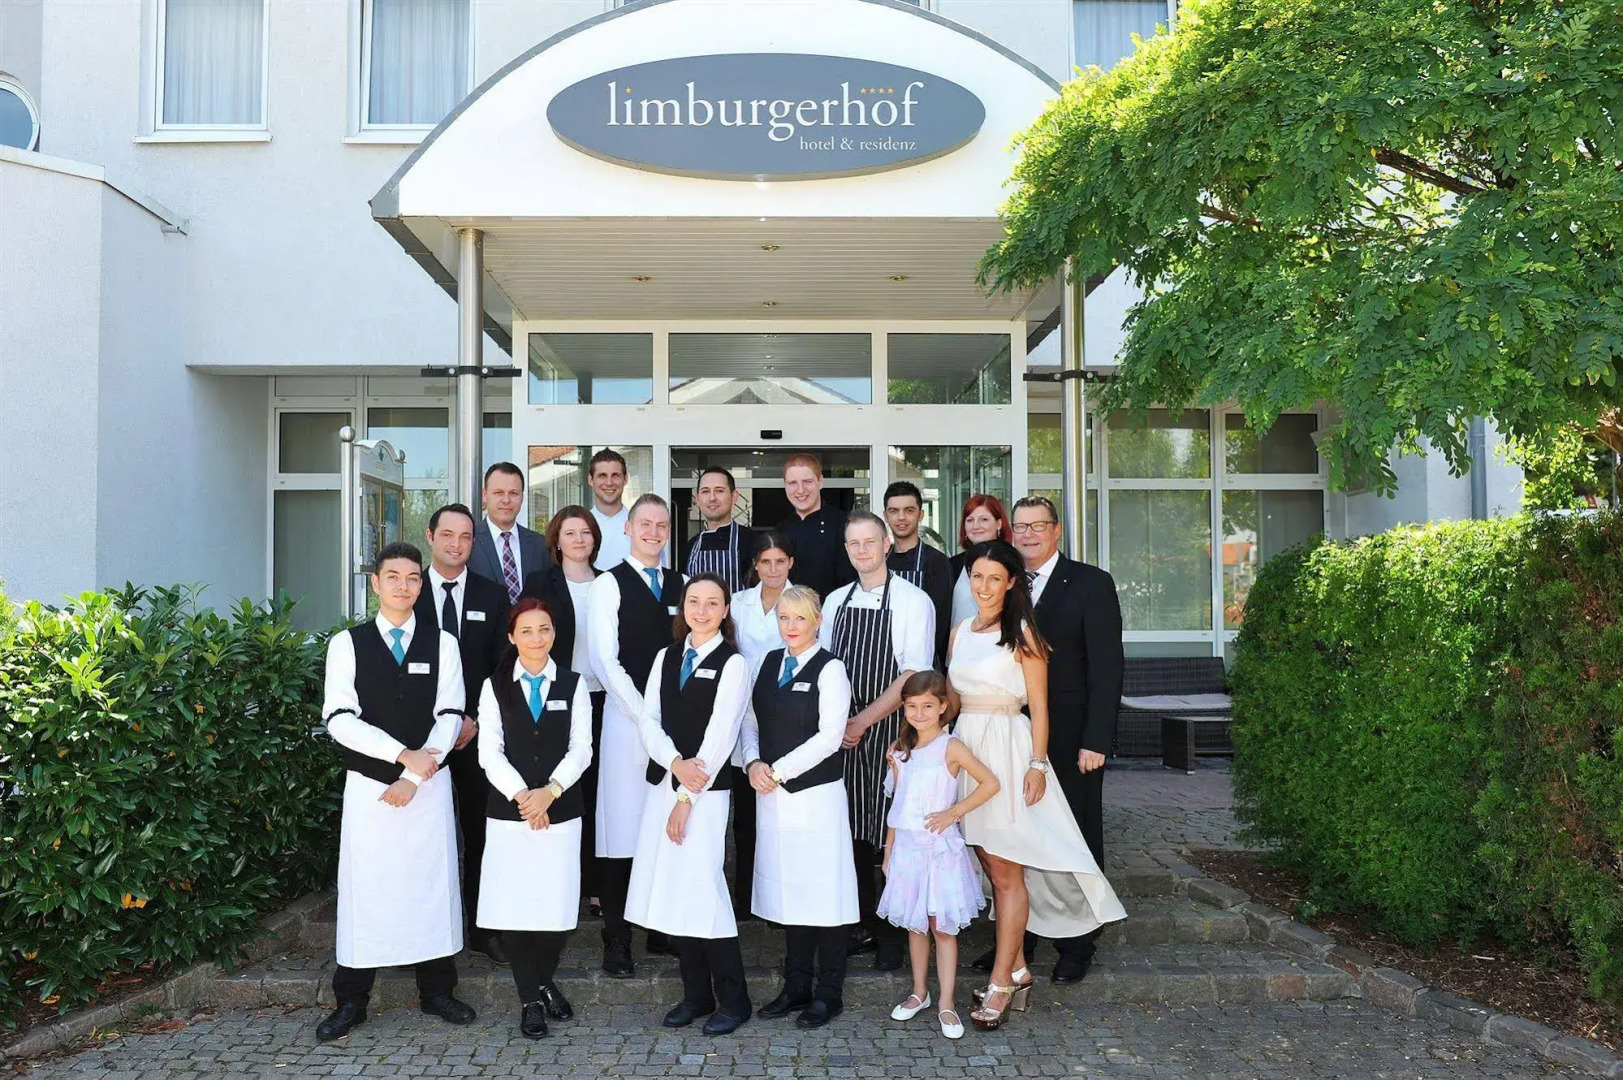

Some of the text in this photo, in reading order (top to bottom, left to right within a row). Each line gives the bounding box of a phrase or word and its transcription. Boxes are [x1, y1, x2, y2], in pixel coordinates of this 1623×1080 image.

[606, 81, 925, 141] limburgerhof
[799, 135, 917, 151] hotel & residenz
